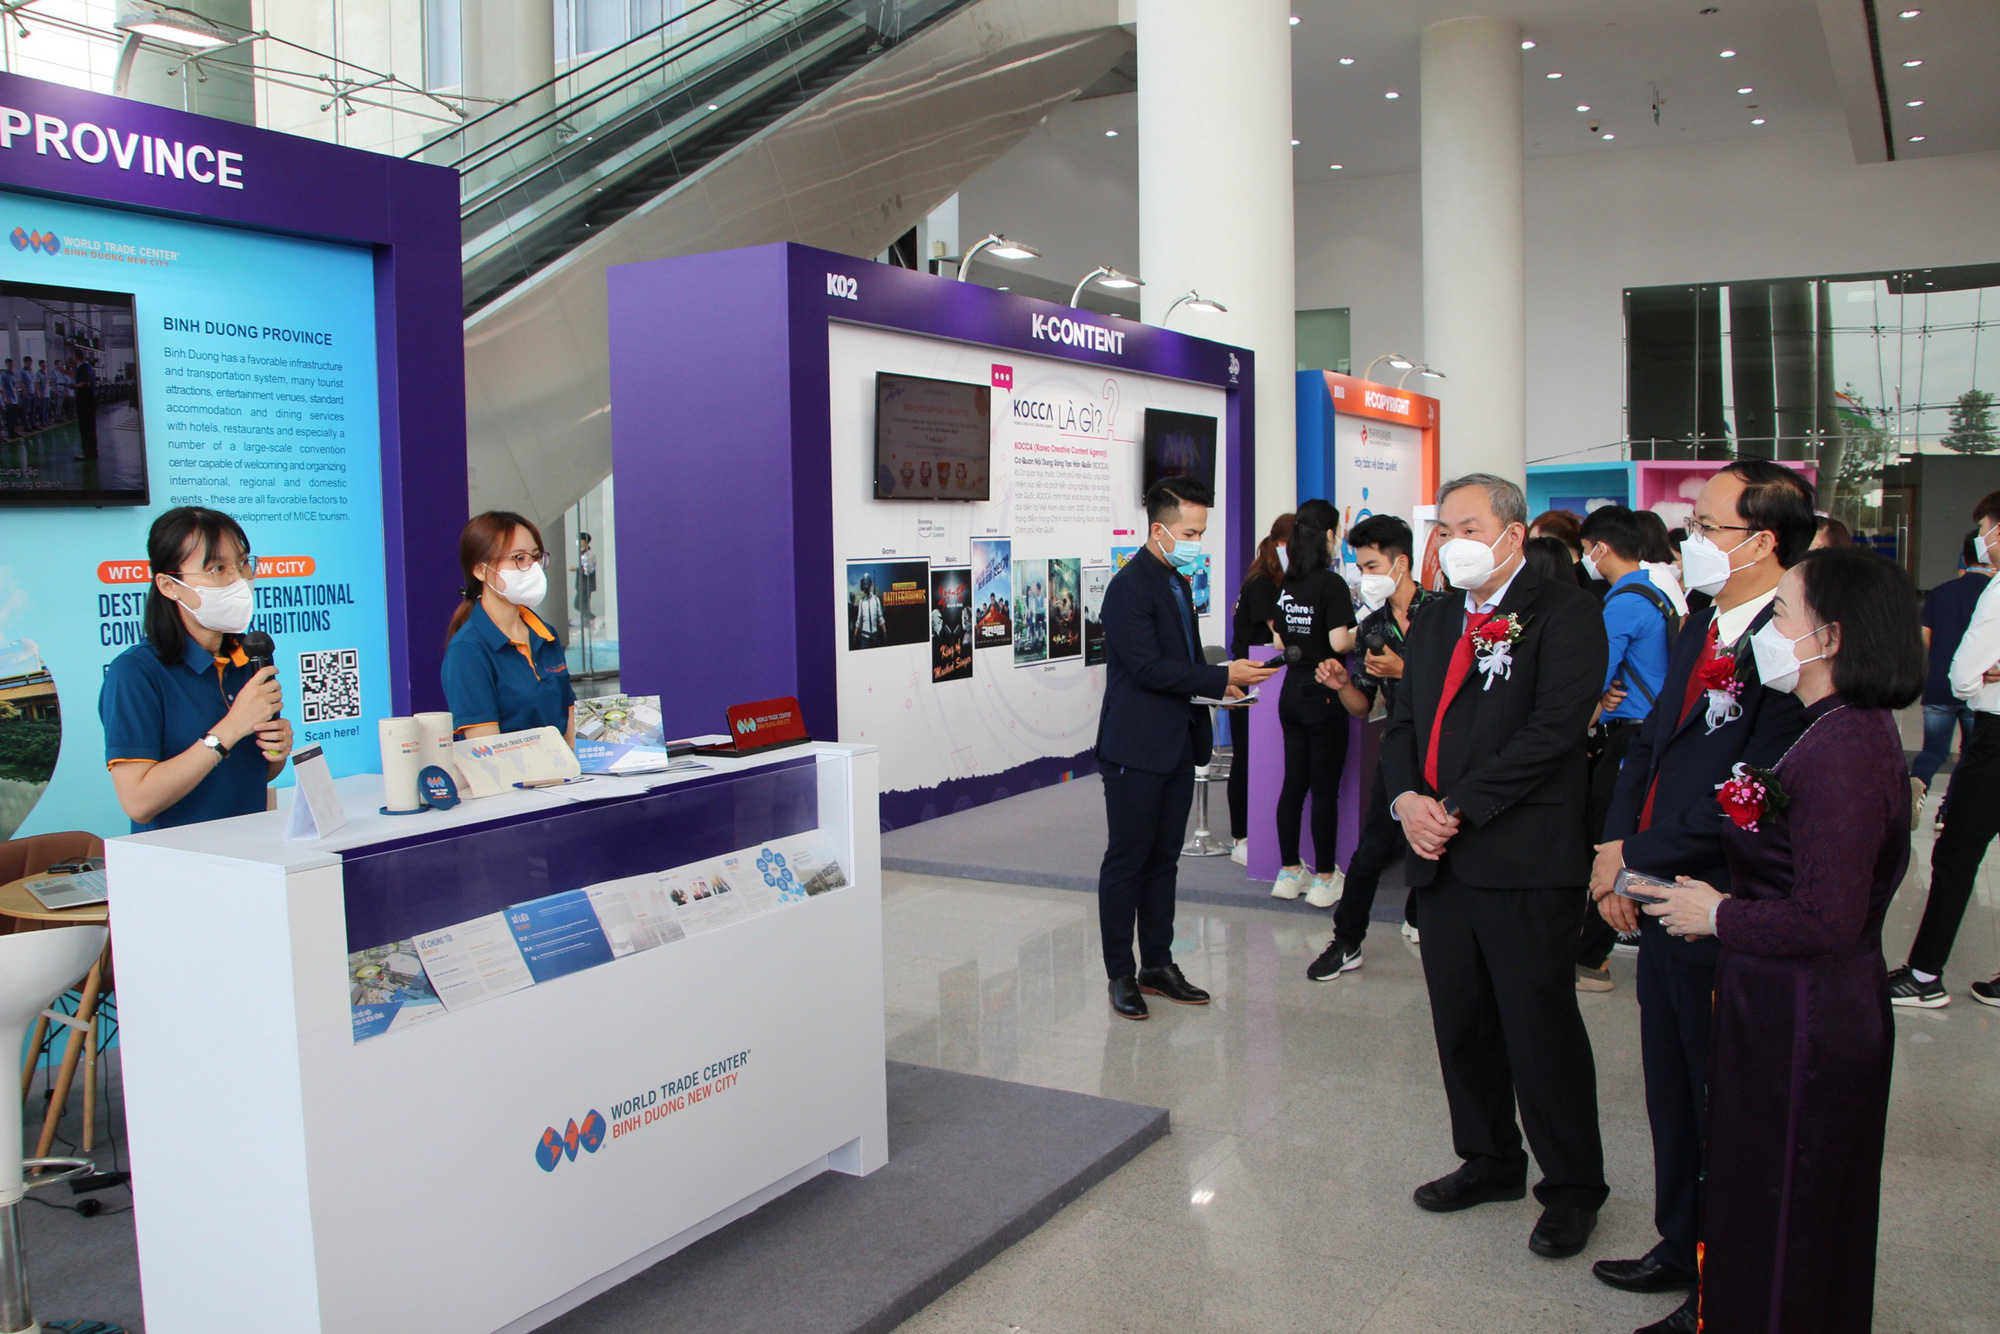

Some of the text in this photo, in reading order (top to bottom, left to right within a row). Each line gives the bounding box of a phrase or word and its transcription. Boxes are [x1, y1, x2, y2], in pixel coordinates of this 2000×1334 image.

[0, 105, 244, 190] PROVINCE
[63, 237, 100, 250] WORLD
[104, 242, 136, 255] TRADE
[64, 248, 169, 268] BINH DUONG NEW CITY
[826, 273, 858, 301] K02
[163, 317, 332, 346] BINH DUONG PROVINCE
[1031, 312, 1125, 355] K-CONTENT
[164, 347, 186, 359] Binh
[188, 349, 219, 364] Duong
[221, 352, 237, 363] has
[248, 354, 287, 367] favorable
[289, 357, 342, 371] infrastructure
[164, 367, 343, 388] and transportation system, many tourist
[165, 385, 344, 405] attractions, entertainment venues, standard
[1365, 390, 1410, 415] K-COPYRIGHT
[167, 403, 344, 421] accommodation and dining services
[1013, 399, 1102, 433] KOCCA LÀ GÌ?
[167, 422, 345, 439] with hotels, restaurants and especially a
[168, 439, 205, 450] number
[213, 440, 222, 450] of
[244, 442, 292, 454] large-scale
[300, 444, 346, 454] convention
[1014, 442, 1033, 450] KOCCA
[1050, 444, 1070, 453] Creative
[1071, 446, 1088, 455] Content
[169, 457, 346, 473] center capable of welcoming and organizing
[169, 475, 347, 489] international, regional and domestic
[171, 494, 202, 504] events
[210, 494, 236, 504] these
[238, 496, 253, 504] are
[255, 494, 265, 504] all
[267, 494, 307, 504] favorable
[309, 495, 337, 504] factors
[339, 496, 348, 504] to
[283, 511, 292, 521] of
[294, 511, 317, 521] MICE
[319, 511, 349, 521] tourism.
[108, 566, 143, 580] WTC
[276, 561, 306, 574] CITY
[98, 592, 147, 618] DEST
[1309, 606, 1314, 614] &
[1296, 626, 1311, 634] 2022
[305, 726, 360, 742] Scan here!
[492, 735, 540, 750] WORLD TRADE CENTER
[611, 1051, 748, 1121] WORLD TRADE CENTER
[612, 1072, 738, 1139] BINH DUONG NEW CITY
